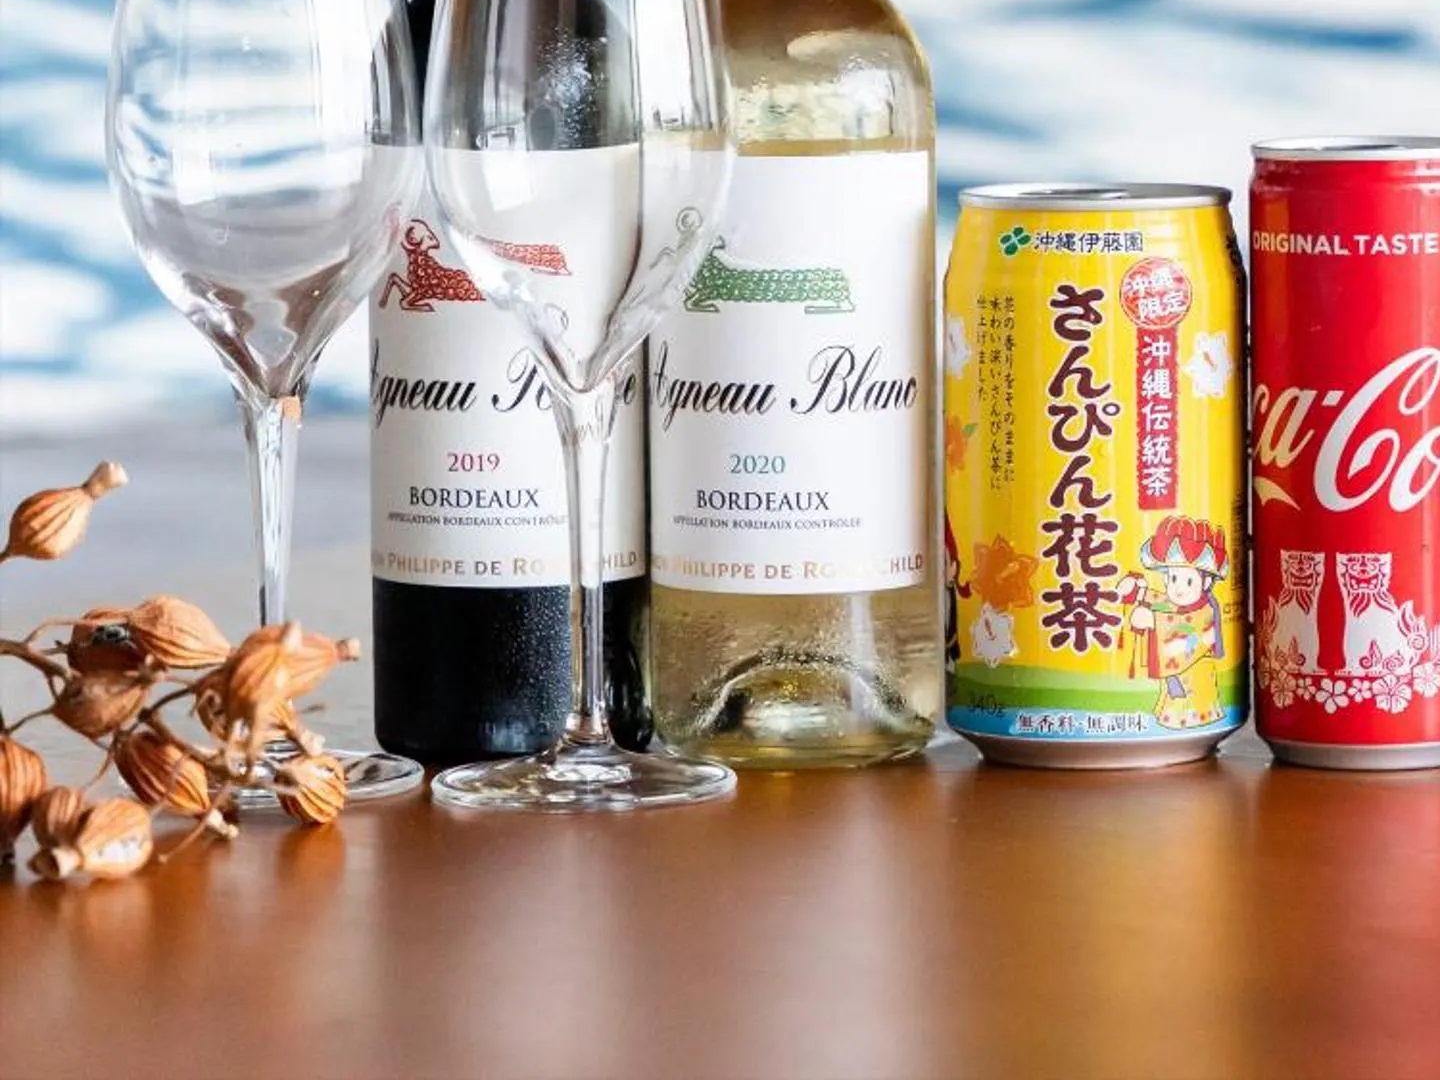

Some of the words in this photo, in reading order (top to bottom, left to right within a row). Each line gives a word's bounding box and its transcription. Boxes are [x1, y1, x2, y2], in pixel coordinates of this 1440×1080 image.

[1034, 231, 1144, 253] 沖縄伊藤園
[1253, 230, 1349, 257] ORIGINAL
[1355, 233, 1440, 256] TASTE
[790, 344, 918, 417] Blanc
[1140, 335, 1174, 498] 沖縄伝統茶
[447, 453, 501, 473] 2019
[729, 453, 786, 475] 2020
[1042, 284, 1122, 653] さんぴん花茶
[409, 487, 540, 510] BORDEAUX
[696, 489, 830, 512] BORDEAUX
[387, 552, 466, 577] PHILIPPE
[474, 559, 502, 577] DE
[764, 562, 793, 580] DE
